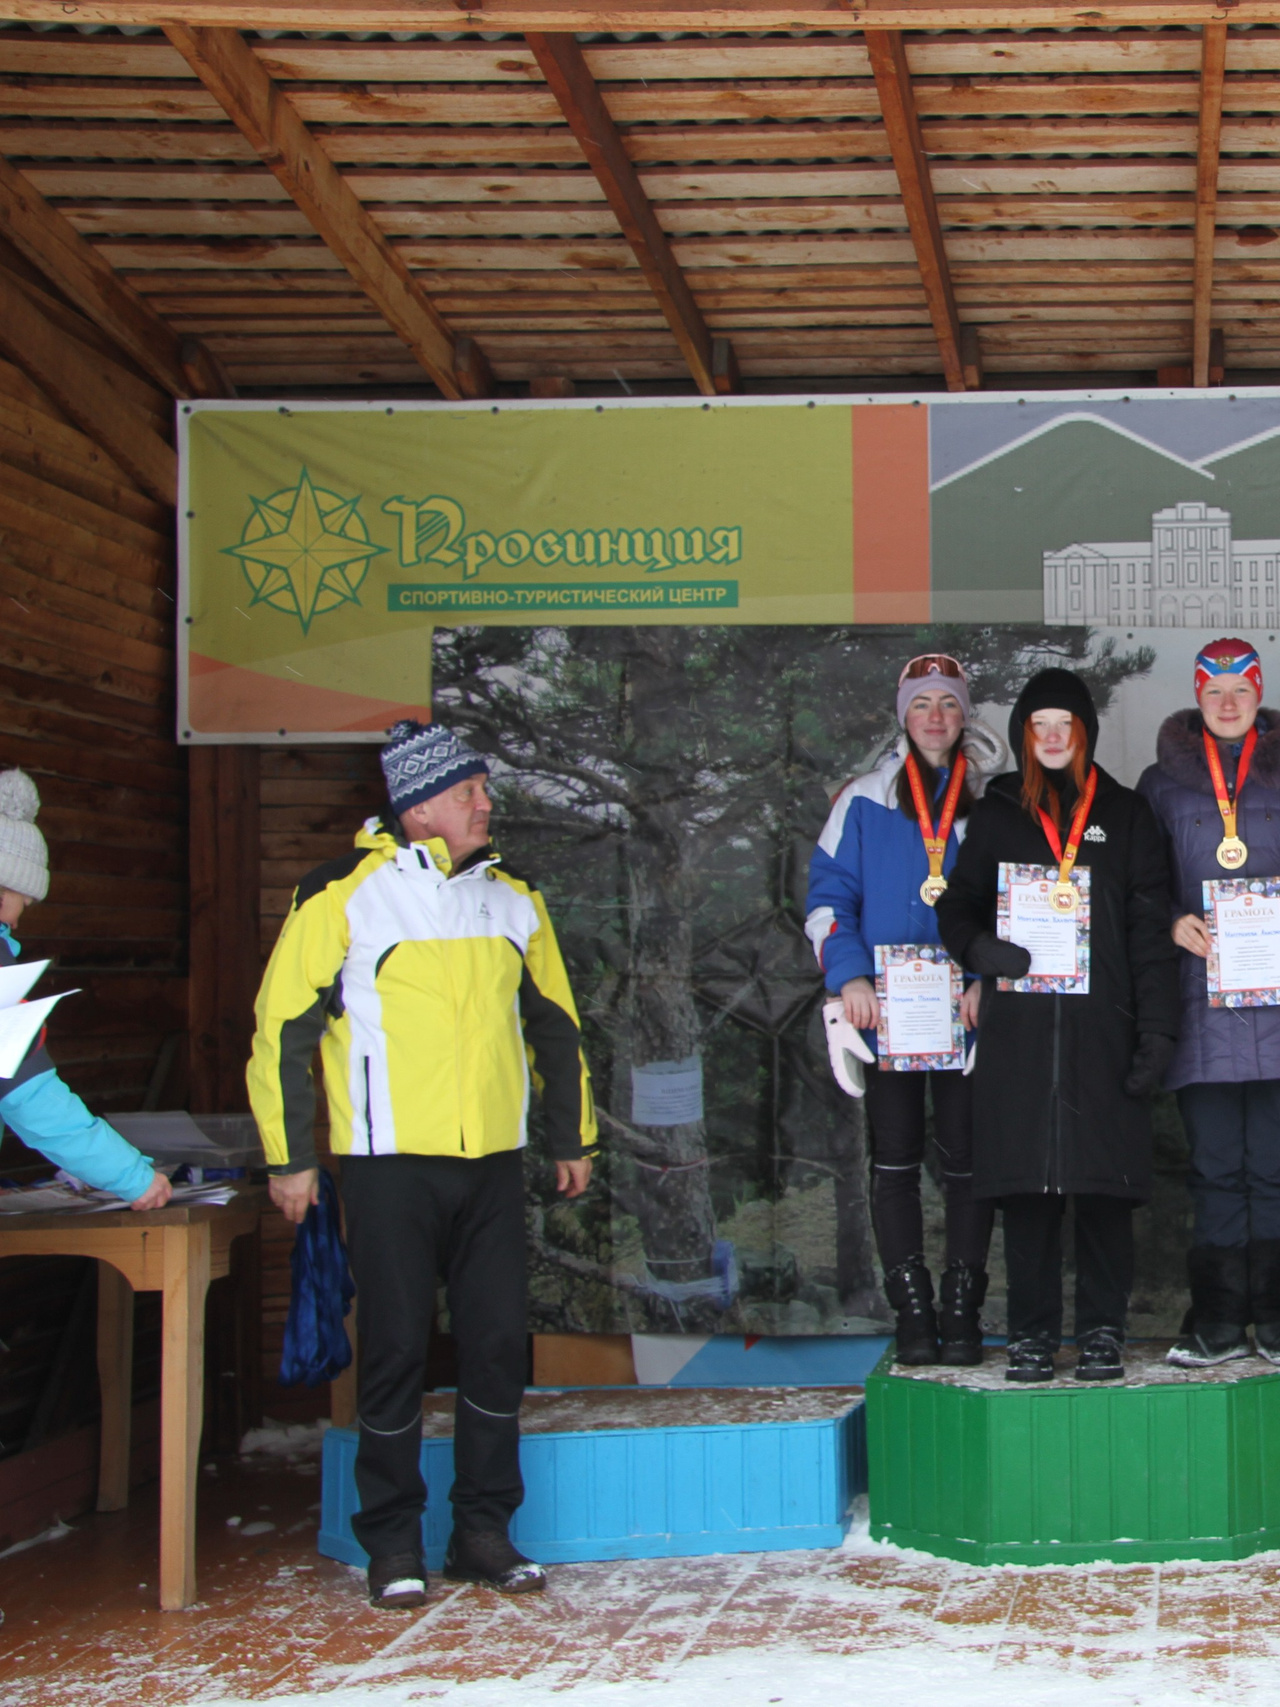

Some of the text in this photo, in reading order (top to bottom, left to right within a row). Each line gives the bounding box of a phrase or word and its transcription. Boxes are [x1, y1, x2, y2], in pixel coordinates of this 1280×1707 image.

[381, 494, 742, 580] Провинция
[399, 586, 727, 605] СПОРТИВНО-ТУРИСТИЧЕСКИЙ ЦЕНТР
[1223, 907, 1275, 918] ГРАМОТА
[893, 973, 943, 983] ГРАМОТА
